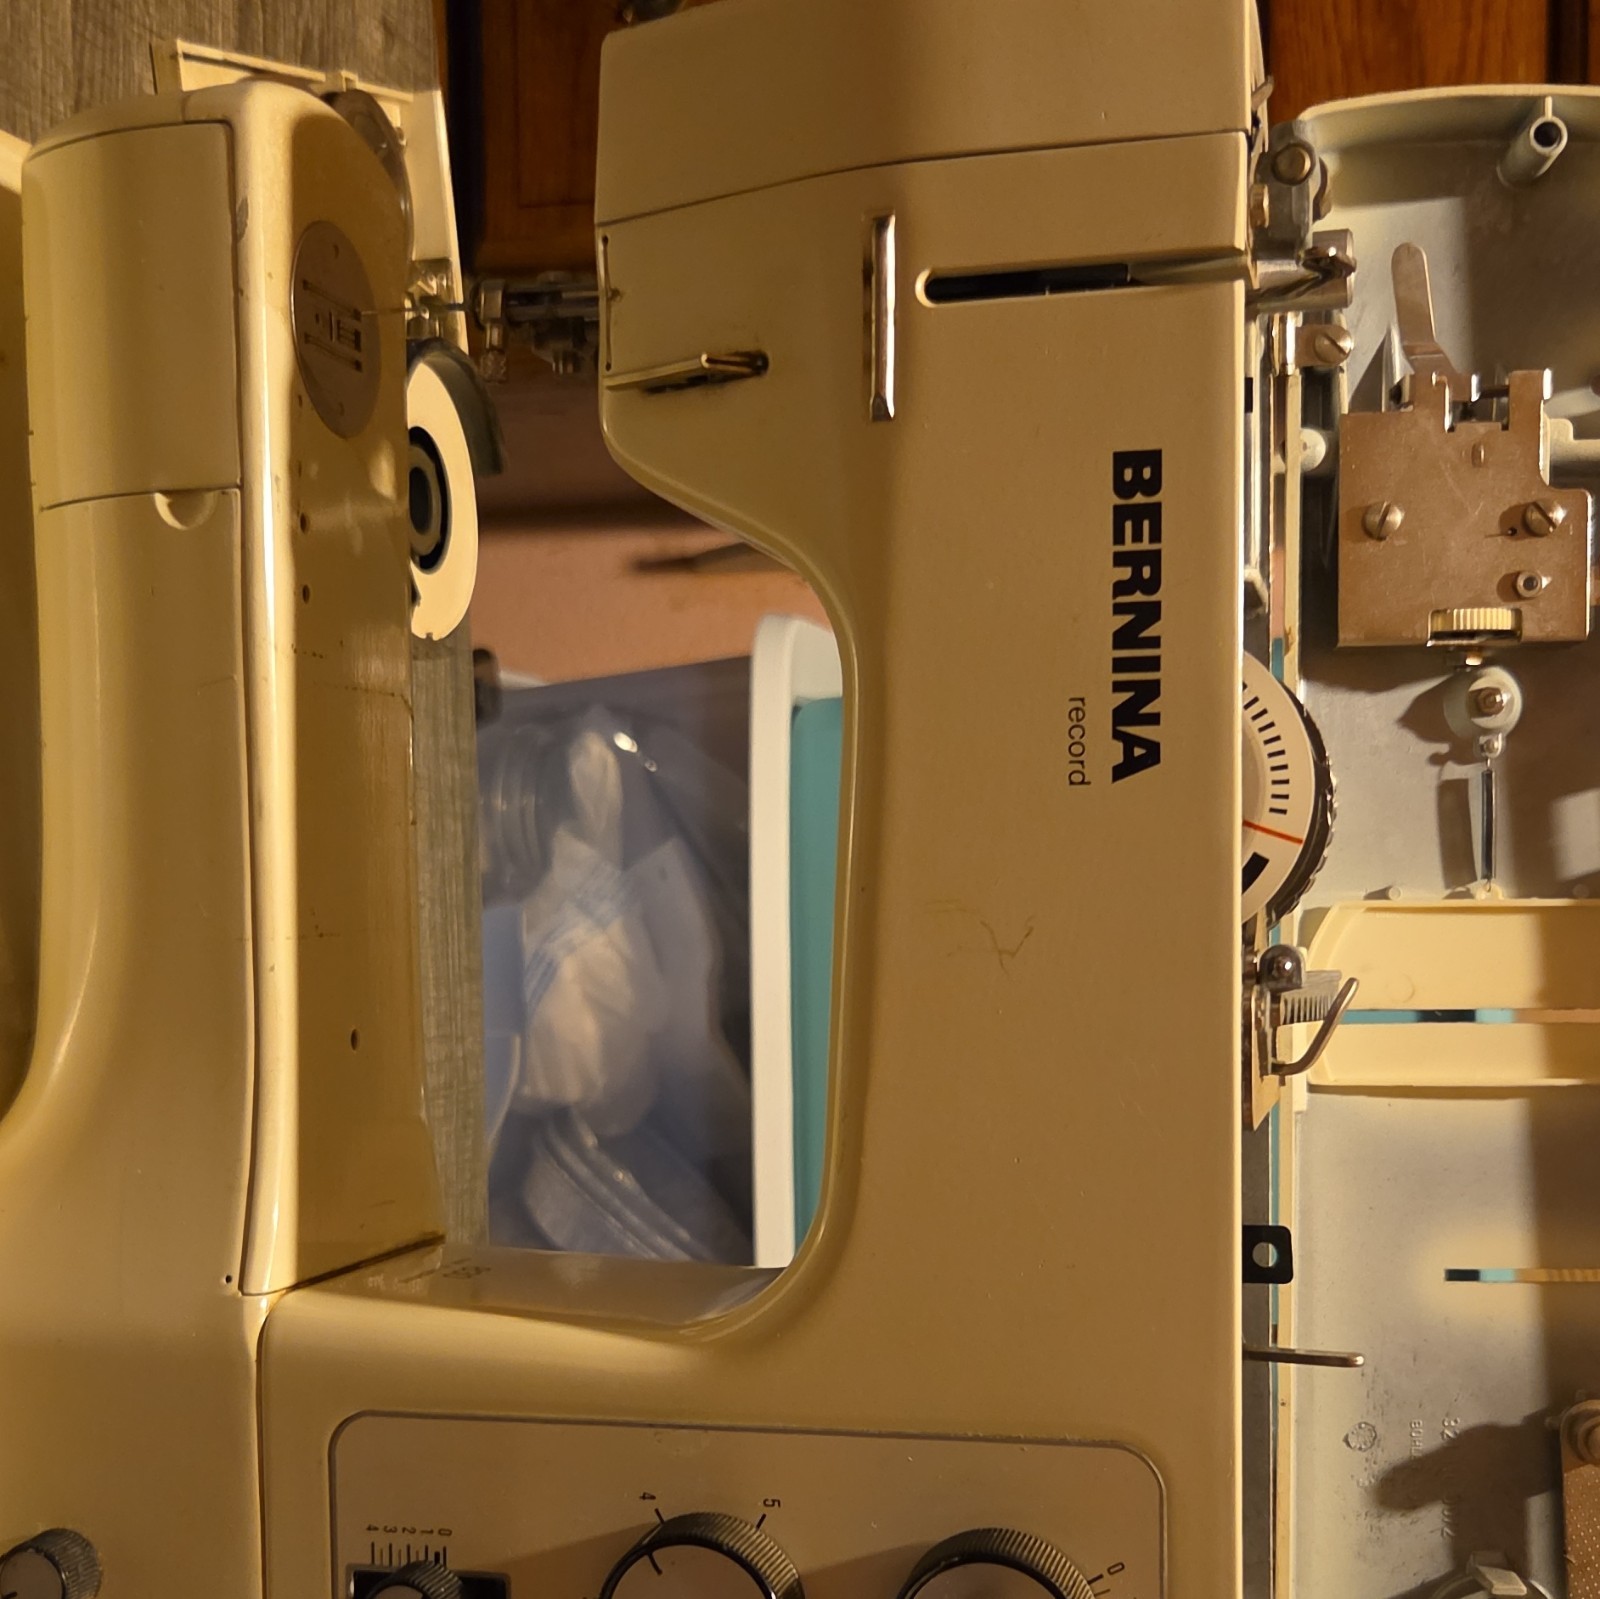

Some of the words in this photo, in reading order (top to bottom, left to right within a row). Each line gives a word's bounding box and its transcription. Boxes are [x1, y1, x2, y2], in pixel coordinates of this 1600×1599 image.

[1112, 448, 1162, 784] BERNINA
[1068, 696, 1091, 786] record
[639, 1492, 657, 1501] 4
[763, 1498, 781, 1508] 5
[366, 1524, 379, 1532] 4
[384, 1525, 398, 1534] 3
[438, 1528, 452, 1536] 0
[1107, 1561, 1125, 1576] 0
